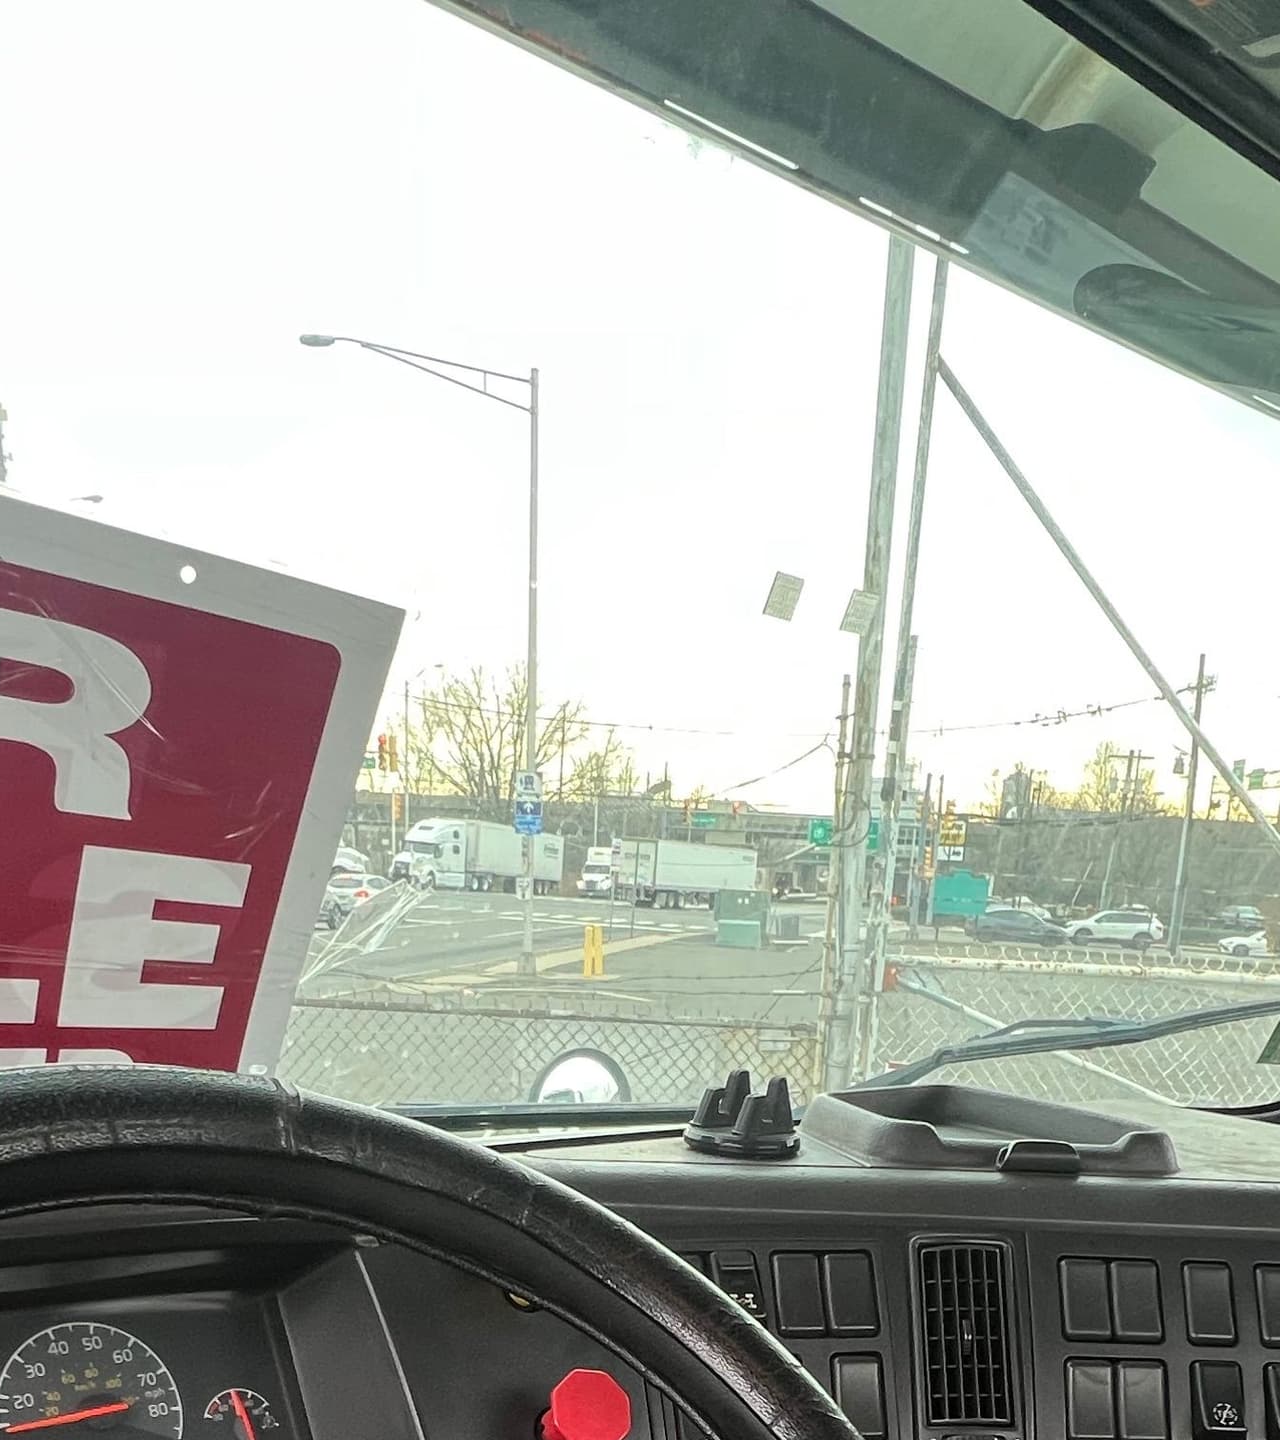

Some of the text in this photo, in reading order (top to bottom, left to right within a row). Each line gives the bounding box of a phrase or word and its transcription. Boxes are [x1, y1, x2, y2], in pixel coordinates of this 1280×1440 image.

[48, 1341, 69, 1356] 40
[82, 1336, 103, 1351] 50
[113, 1349, 133, 1364] 60
[24, 1363, 46, 1379] 30
[137, 1372, 157, 1387] 70
[13, 1393, 34, 1410] 20
[148, 1403, 169, 1418] 80
